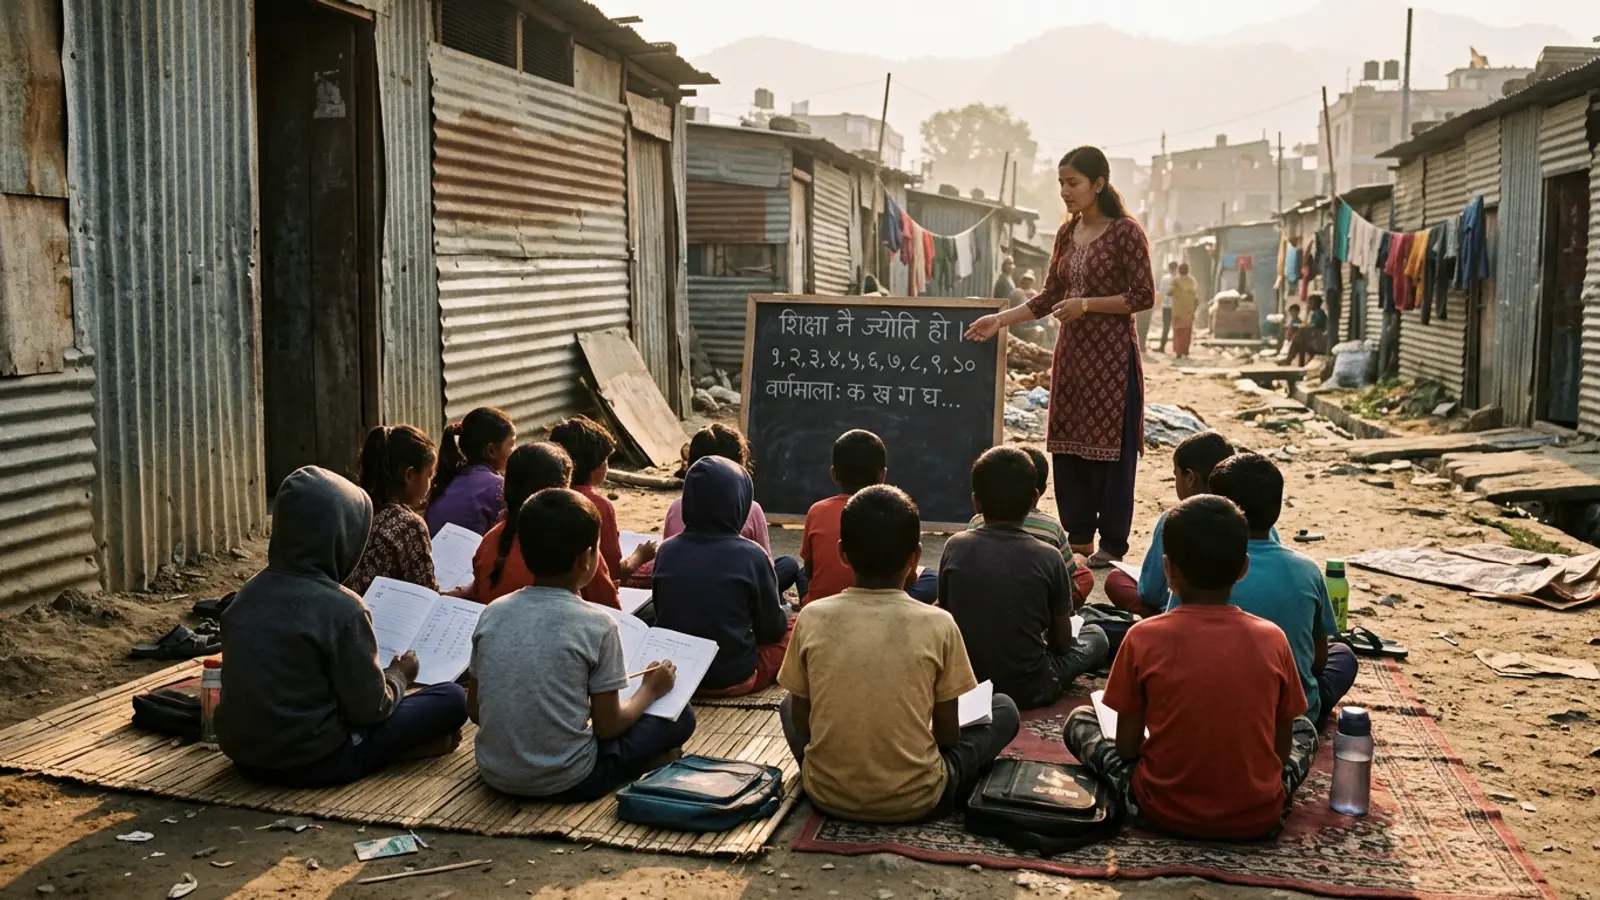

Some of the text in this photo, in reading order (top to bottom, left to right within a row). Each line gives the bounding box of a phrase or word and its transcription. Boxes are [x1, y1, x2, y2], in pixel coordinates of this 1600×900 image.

[778, 308, 830, 338] शिक्षा
[836, 308, 856, 337] नै
[861, 310, 920, 340] ज्योति
[928, 312, 952, 344] हो
[847, 383, 866, 402] क
[873, 384, 893, 405] ख
[898, 386, 916, 406] ग
